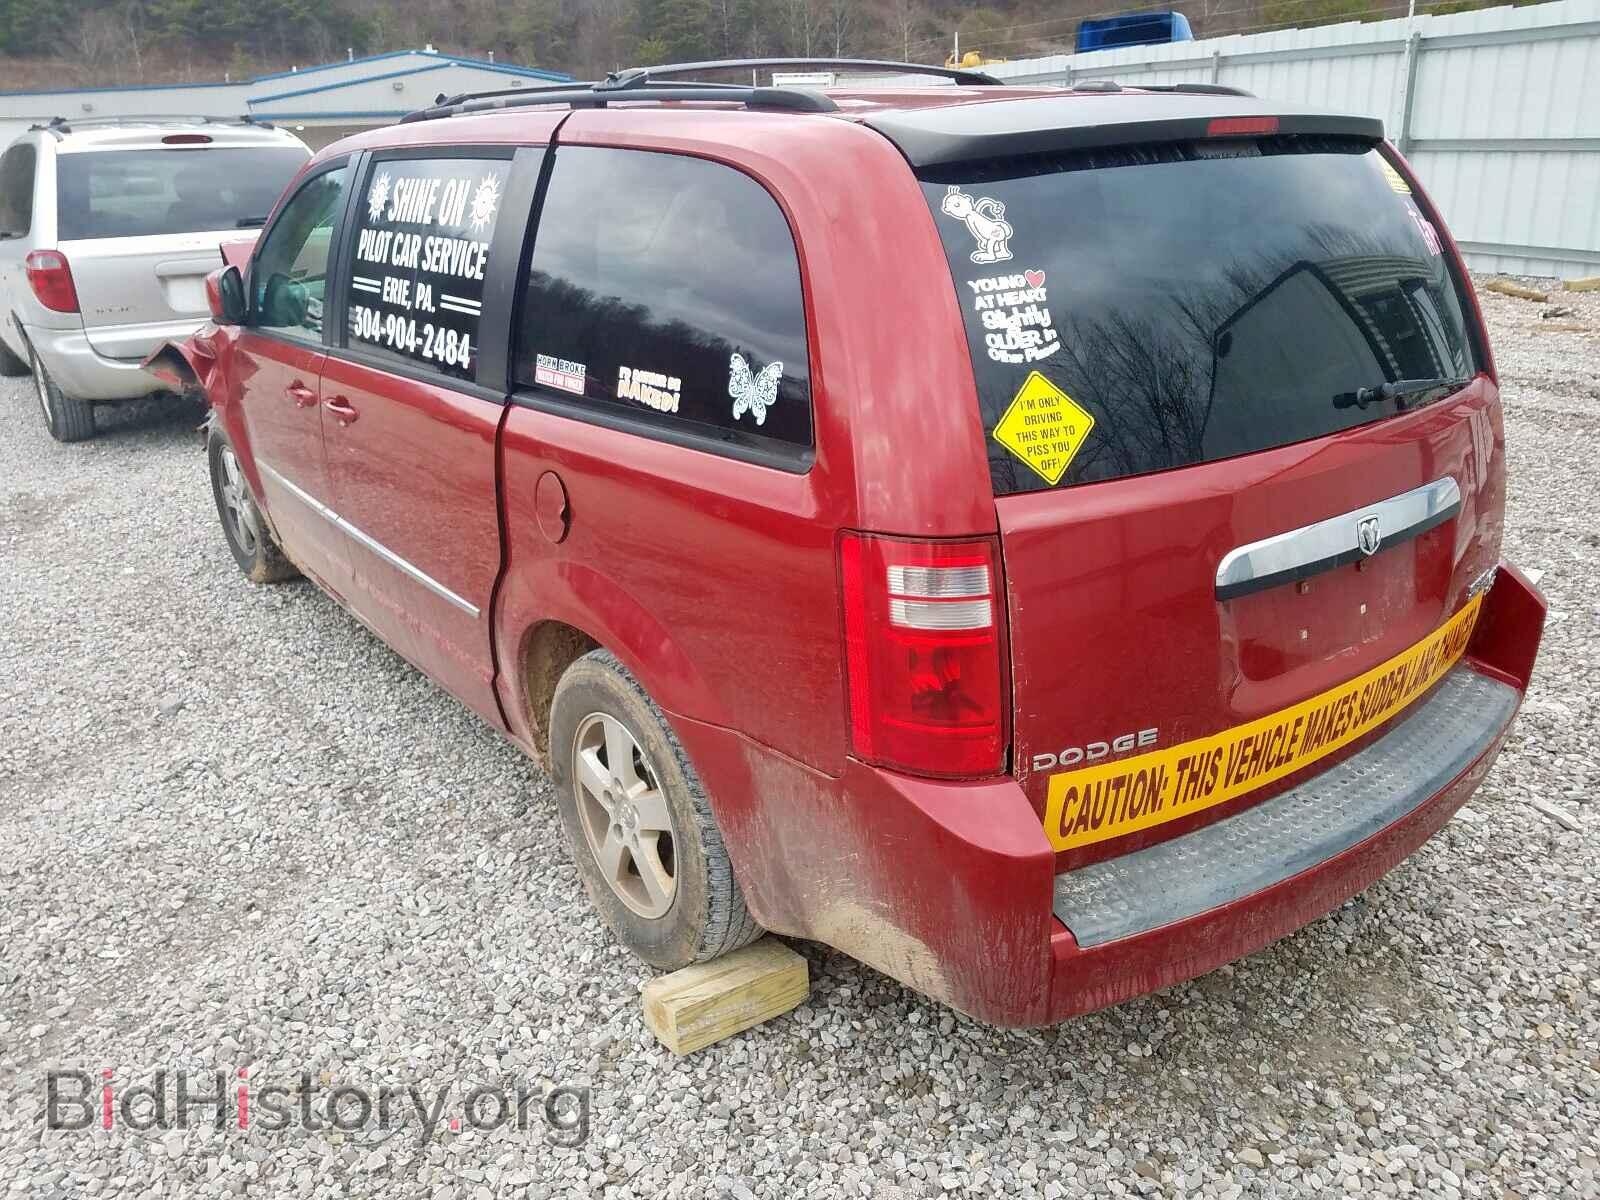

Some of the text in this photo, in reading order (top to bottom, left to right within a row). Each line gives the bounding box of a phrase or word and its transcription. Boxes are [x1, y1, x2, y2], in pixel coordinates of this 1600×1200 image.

[387, 177, 471, 226] SHINE ON
[357, 228, 489, 281] PILOT CAR SERVICE
[967, 274, 1027, 294] YOUNG
[383, 276, 436, 313] ERIE, PA.
[975, 288, 1047, 310] AT HEART
[354, 305, 471, 369] 304-904-2484
[985, 331, 1043, 350] OLDER
[558, 358, 586, 378] BROKE
[1020, 395, 1061, 411] I'M ONLY
[1024, 411, 1063, 425] DRIVING
[1016, 424, 1076, 443] THIS WAY TO
[1026, 440, 1071, 457] PISS YOU
[1041, 457, 1060, 471] OFF!
[1032, 727, 1159, 772] DODGE
[1058, 763, 1169, 839] CAUTION:
[1172, 745, 1224, 808] THIS
[1223, 714, 1305, 790] VEHICLE
[1297, 689, 1359, 757] MAKES
[1359, 662, 1409, 726] SUDDEN
